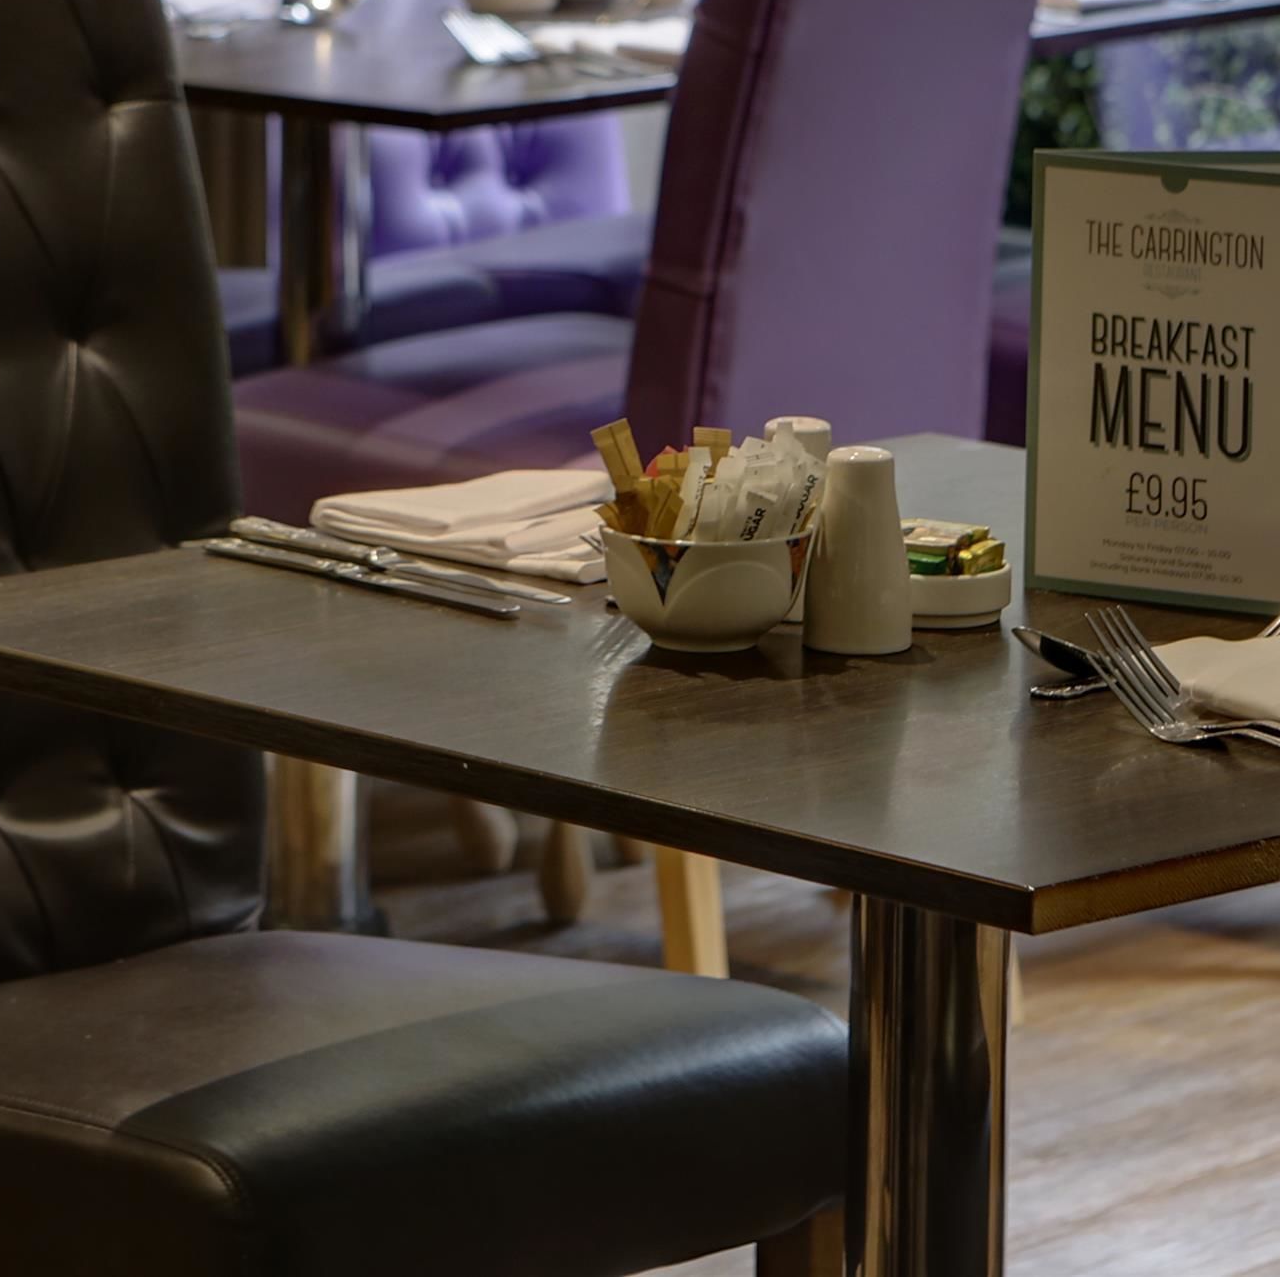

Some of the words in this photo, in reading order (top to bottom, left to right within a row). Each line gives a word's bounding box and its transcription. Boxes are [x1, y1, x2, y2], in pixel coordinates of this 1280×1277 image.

[1086, 219, 1124, 258] THE
[1130, 224, 1265, 270] CARRINGTON
[1091, 312, 1255, 369] BREAKFAST
[1090, 362, 1253, 463] MENU
[1125, 472, 1208, 521] £9.95
[743, 507, 767, 542] UGAR
[1125, 515, 1151, 529] PER
[1154, 518, 1208, 534] PERSON
